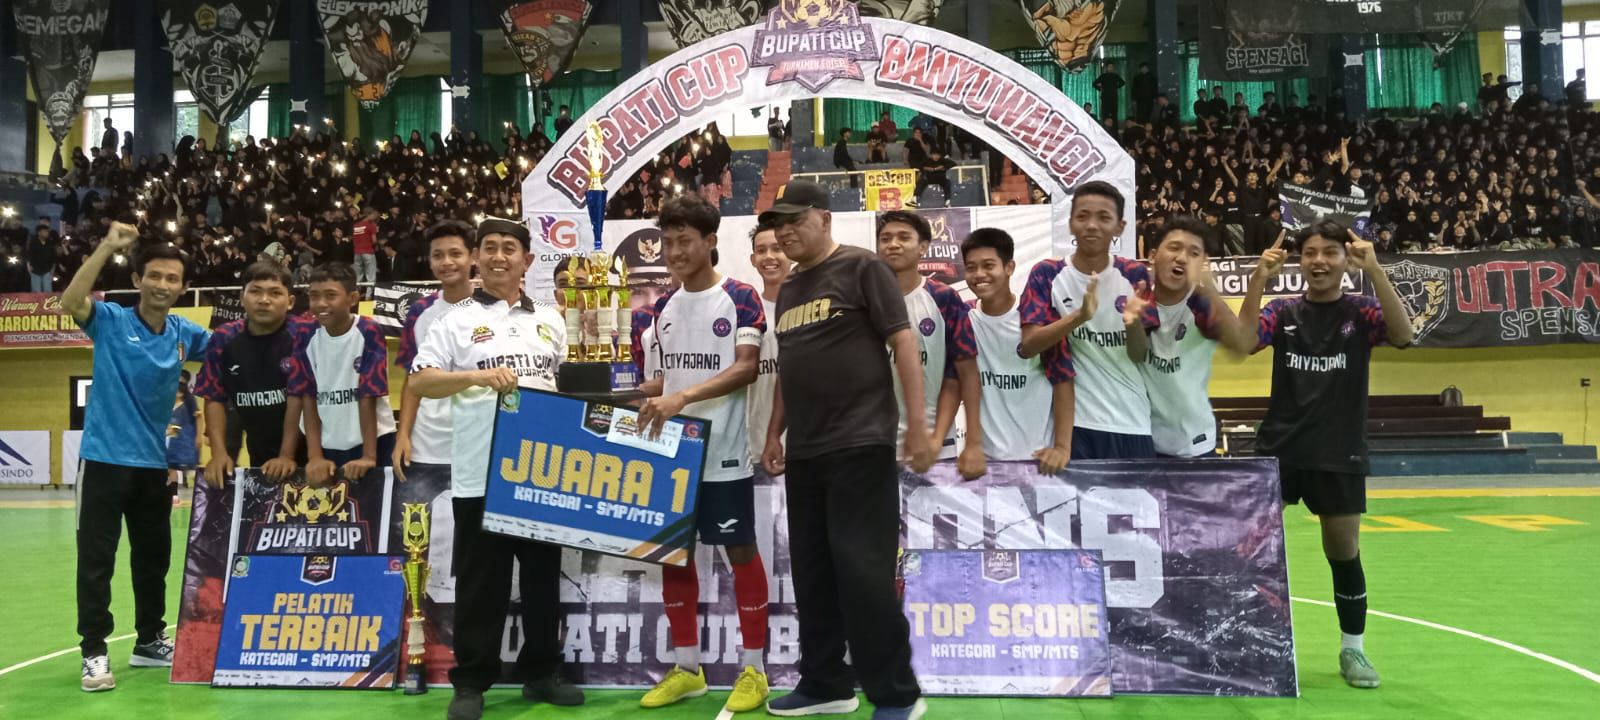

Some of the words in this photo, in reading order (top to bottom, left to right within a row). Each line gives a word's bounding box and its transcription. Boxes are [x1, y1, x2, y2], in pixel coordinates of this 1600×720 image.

[317, 0, 429, 16] ELEKTRONIKA
[1357, 1, 1382, 14] 1976
[761, 32, 826, 58] BUPATI
[829, 30, 866, 52] CUP
[1226, 43, 1309, 70] SPENSAGI
[549, 79, 679, 203] BUPATI
[665, 44, 748, 111] CUP
[877, 36, 1106, 188] BANYUWANGI
[934, 244, 959, 260] CUP
[1501, 306, 1600, 341] SPENS
[236, 387, 288, 408] CRIYAJAN
[500, 439, 654, 508] JUARA
[670, 467, 690, 514] 1
[514, 485, 582, 511] KATEGORI
[596, 500, 665, 527] SMP/MTS
[256, 527, 322, 551] BUPATI
[325, 527, 362, 550] CUP
[273, 593, 354, 615] PELATIH
[240, 614, 383, 652] TERBAIK
[908, 602, 976, 638] TOP
[988, 602, 1100, 639] SCORE
[239, 652, 297, 666] KATEGORI
[310, 652, 371, 668] SMP/MTS
[931, 643, 996, 659] KATEGORI
[1012, 644, 1079, 660] SMP/MTS
